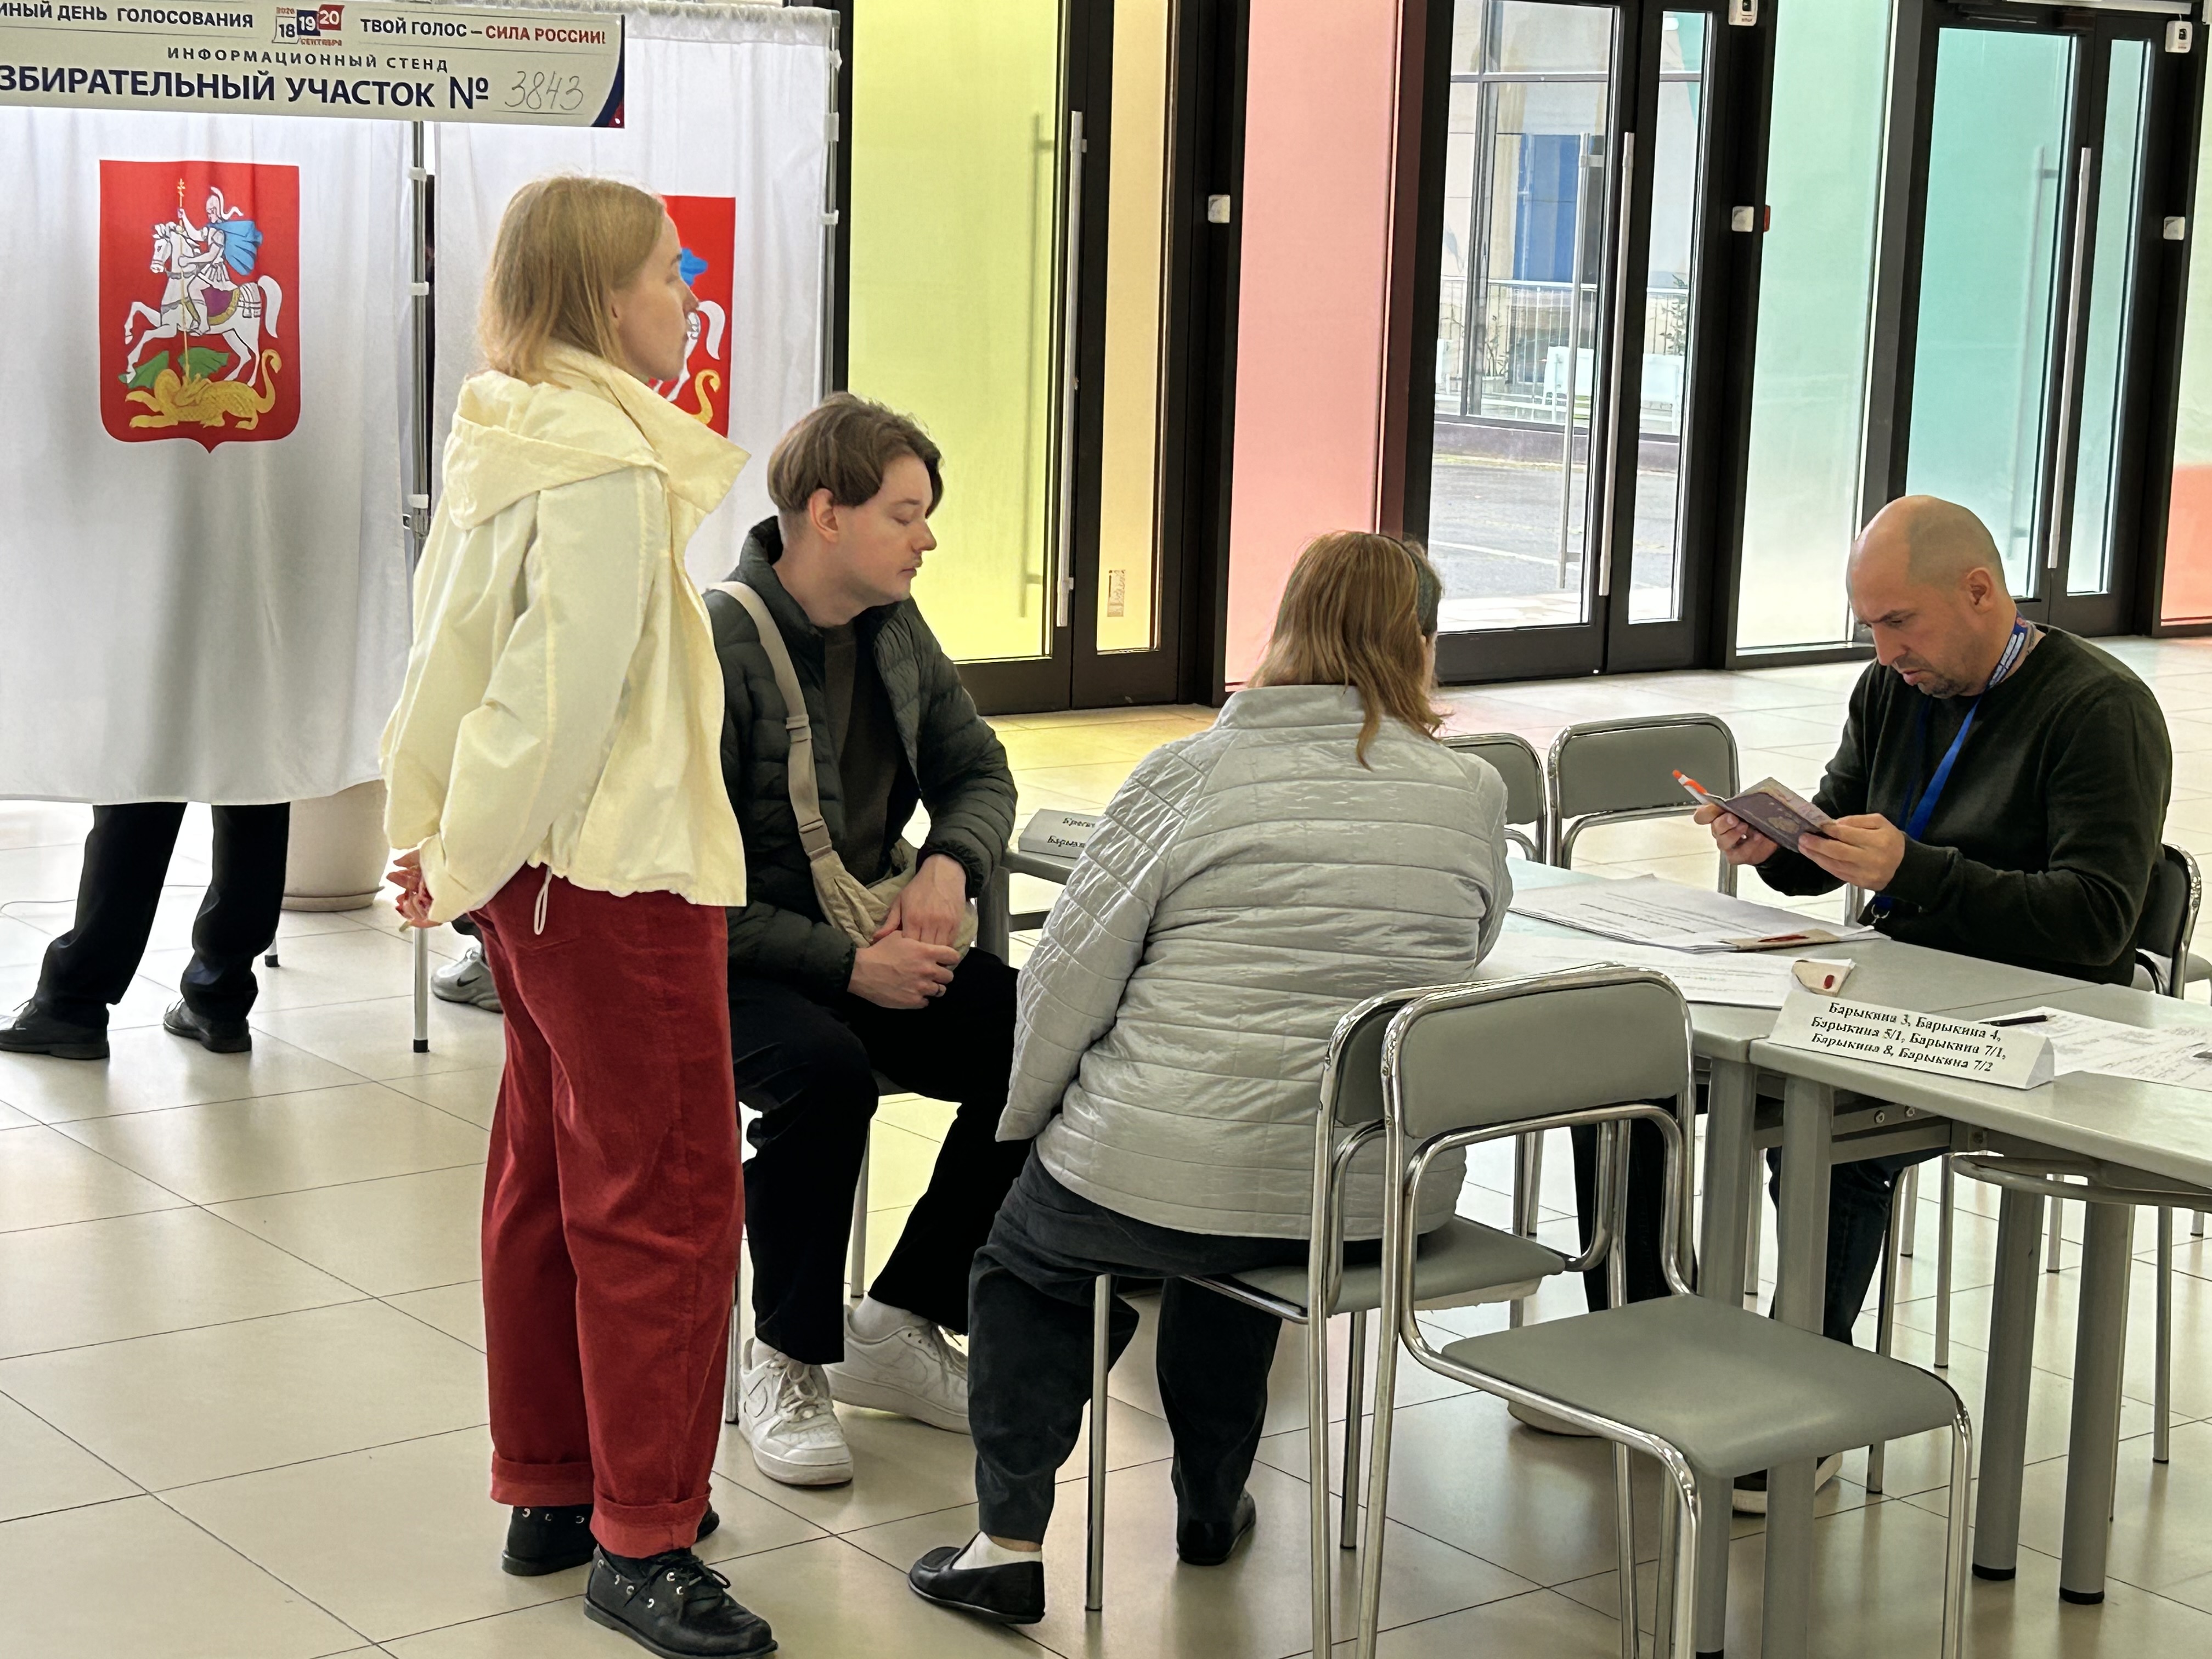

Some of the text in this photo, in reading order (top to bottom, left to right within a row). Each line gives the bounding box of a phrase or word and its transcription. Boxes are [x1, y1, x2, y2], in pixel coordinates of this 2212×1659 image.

[58, 5, 108, 21] ДЕНЬ
[117, 8, 253, 28] ГОЛОСОВАНИЯ
[278, 10, 340, 38] 18 19 20
[360, 17, 407, 34] ТВОЙ
[411, 21, 467, 37] ГОЛОС
[486, 25, 531, 41] СИЛА
[167, 47, 448, 73] ИНФОРМАЦИОННЫЙ СТЕНД
[285, 76, 436, 108] УЧАСТОК
[450, 76, 489, 109] №
[504, 70, 584, 111] 3843
[1810, 1016, 1880, 1037] Барыкина
[1909, 1032, 1980, 1054] Барыкина
[1829, 1002, 1898, 1024] Барыкина
[1915, 1016, 1987, 1039] Барыкина
[1811, 1032, 1881, 1053] Барыкина
[1898, 1047, 1969, 1068] Барыкина
[1973, 1059, 1994, 1072] 7/2
